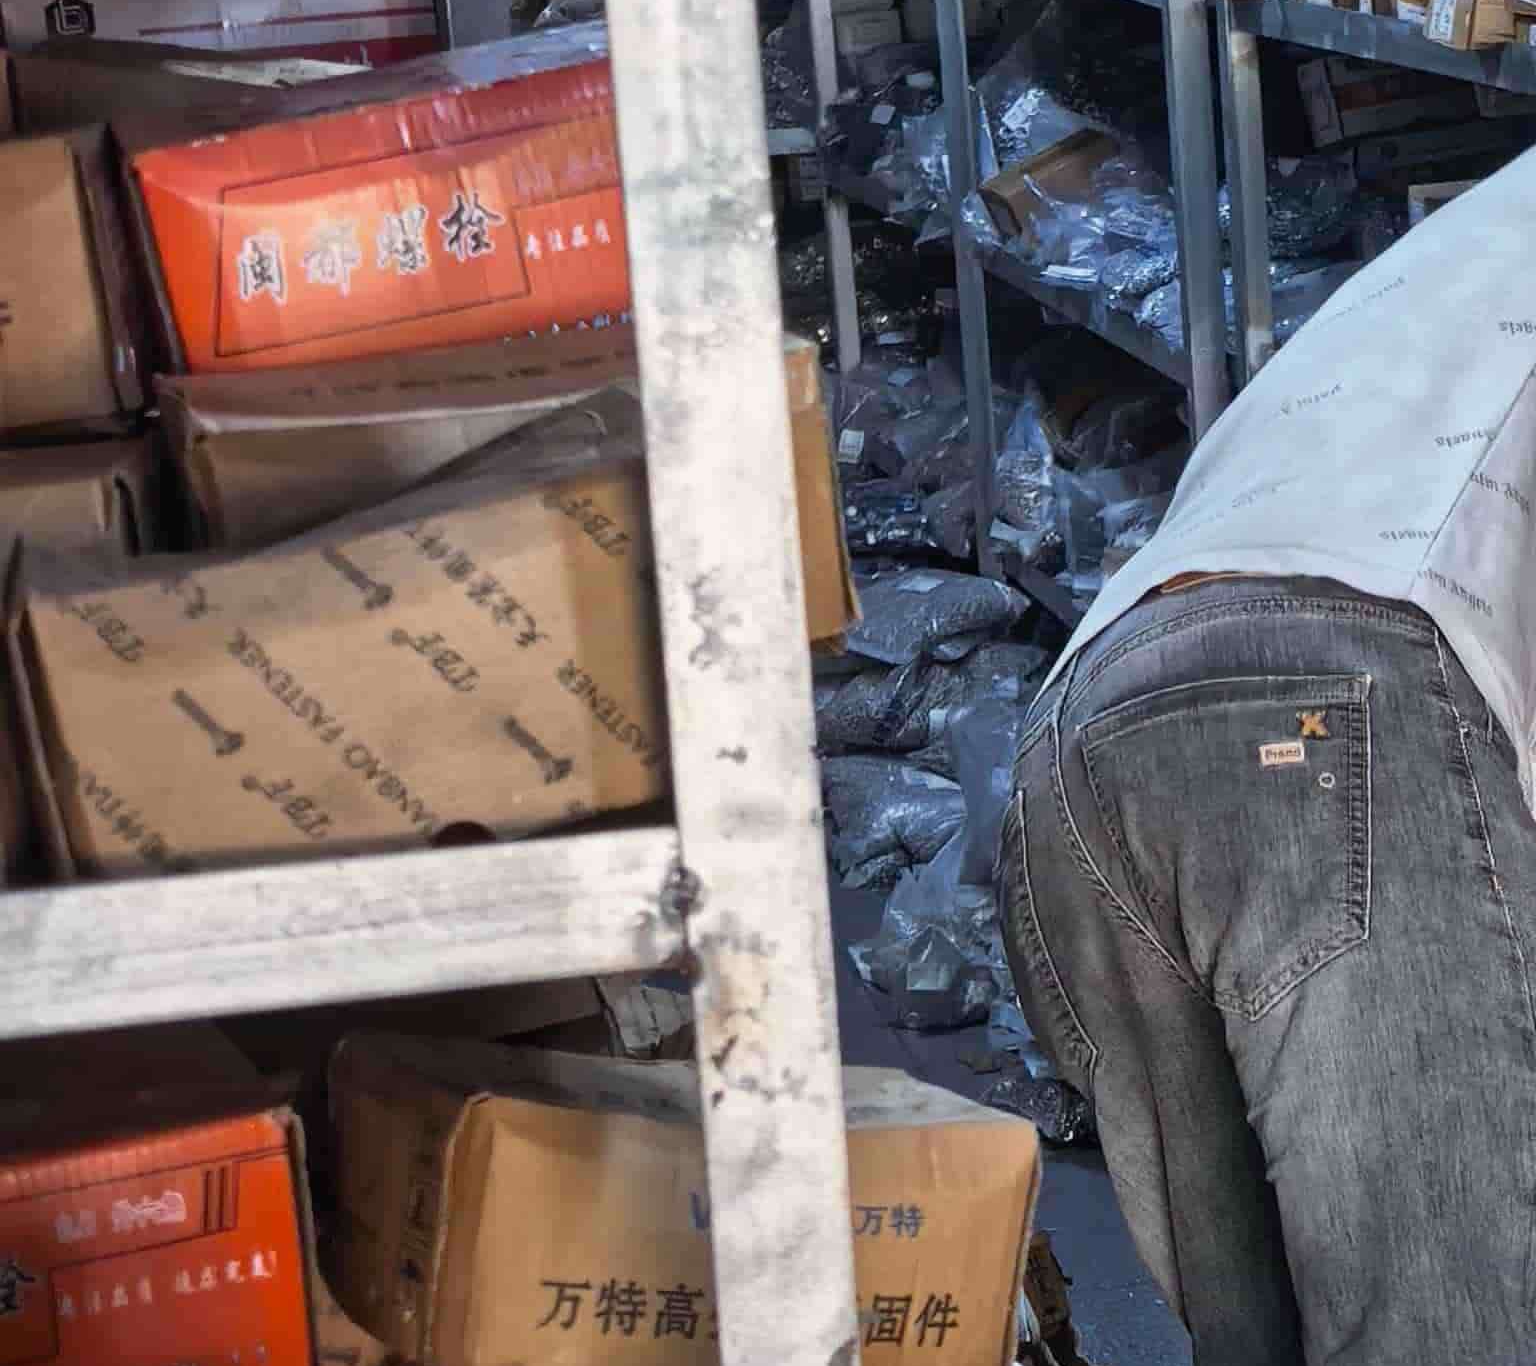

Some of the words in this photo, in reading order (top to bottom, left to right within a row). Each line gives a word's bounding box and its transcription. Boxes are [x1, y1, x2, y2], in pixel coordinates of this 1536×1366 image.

[227, 629, 343, 745] FASTENER
[341, 739, 440, 837] ANBAO
[854, 1203, 926, 1240] 万特
